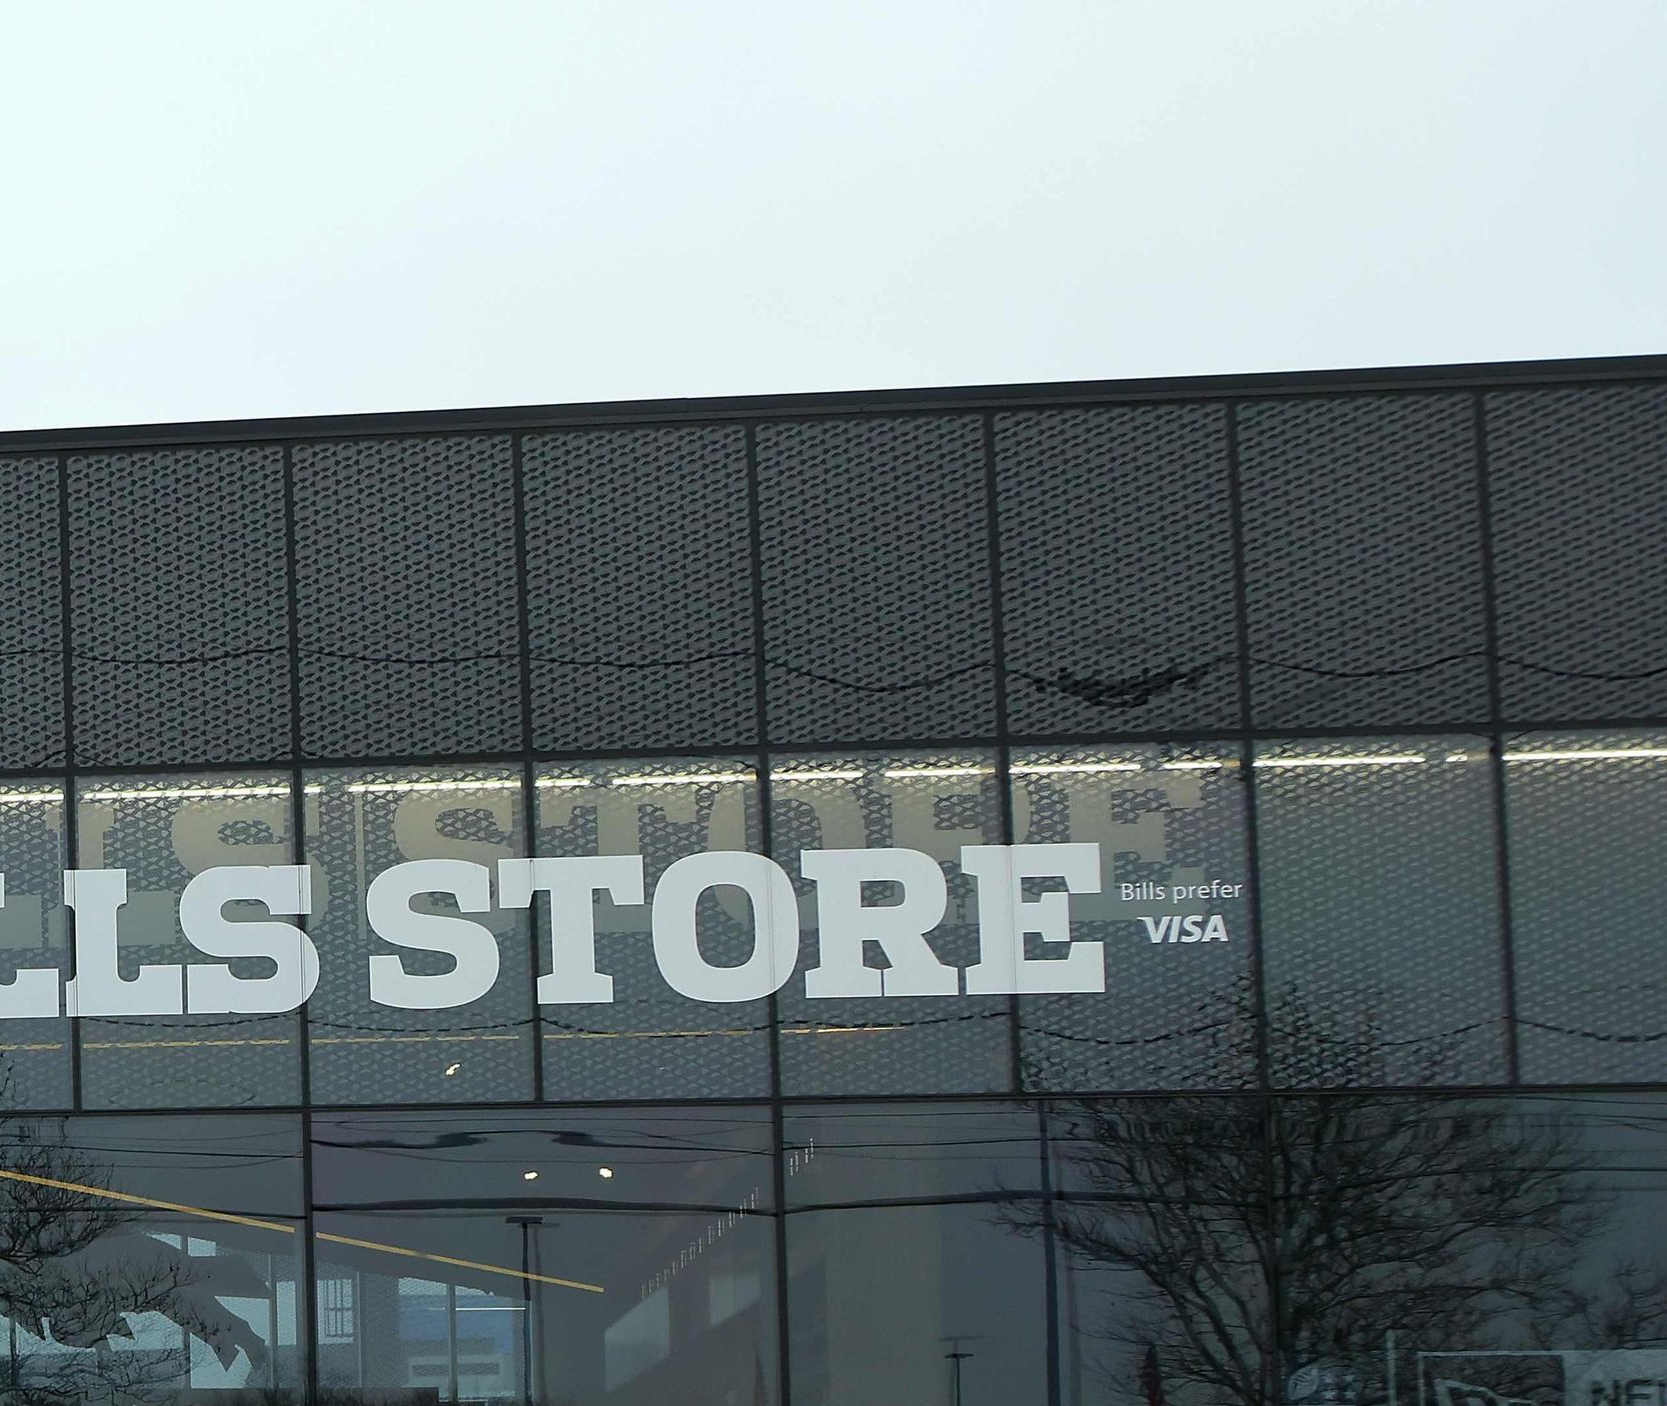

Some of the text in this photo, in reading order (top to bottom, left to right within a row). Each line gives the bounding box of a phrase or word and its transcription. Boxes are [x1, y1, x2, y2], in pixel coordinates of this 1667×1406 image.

[1121, 879, 1243, 905] Bills prefer
[367, 842, 1106, 1009] STORE
[1139, 915, 1229, 944] VISA
